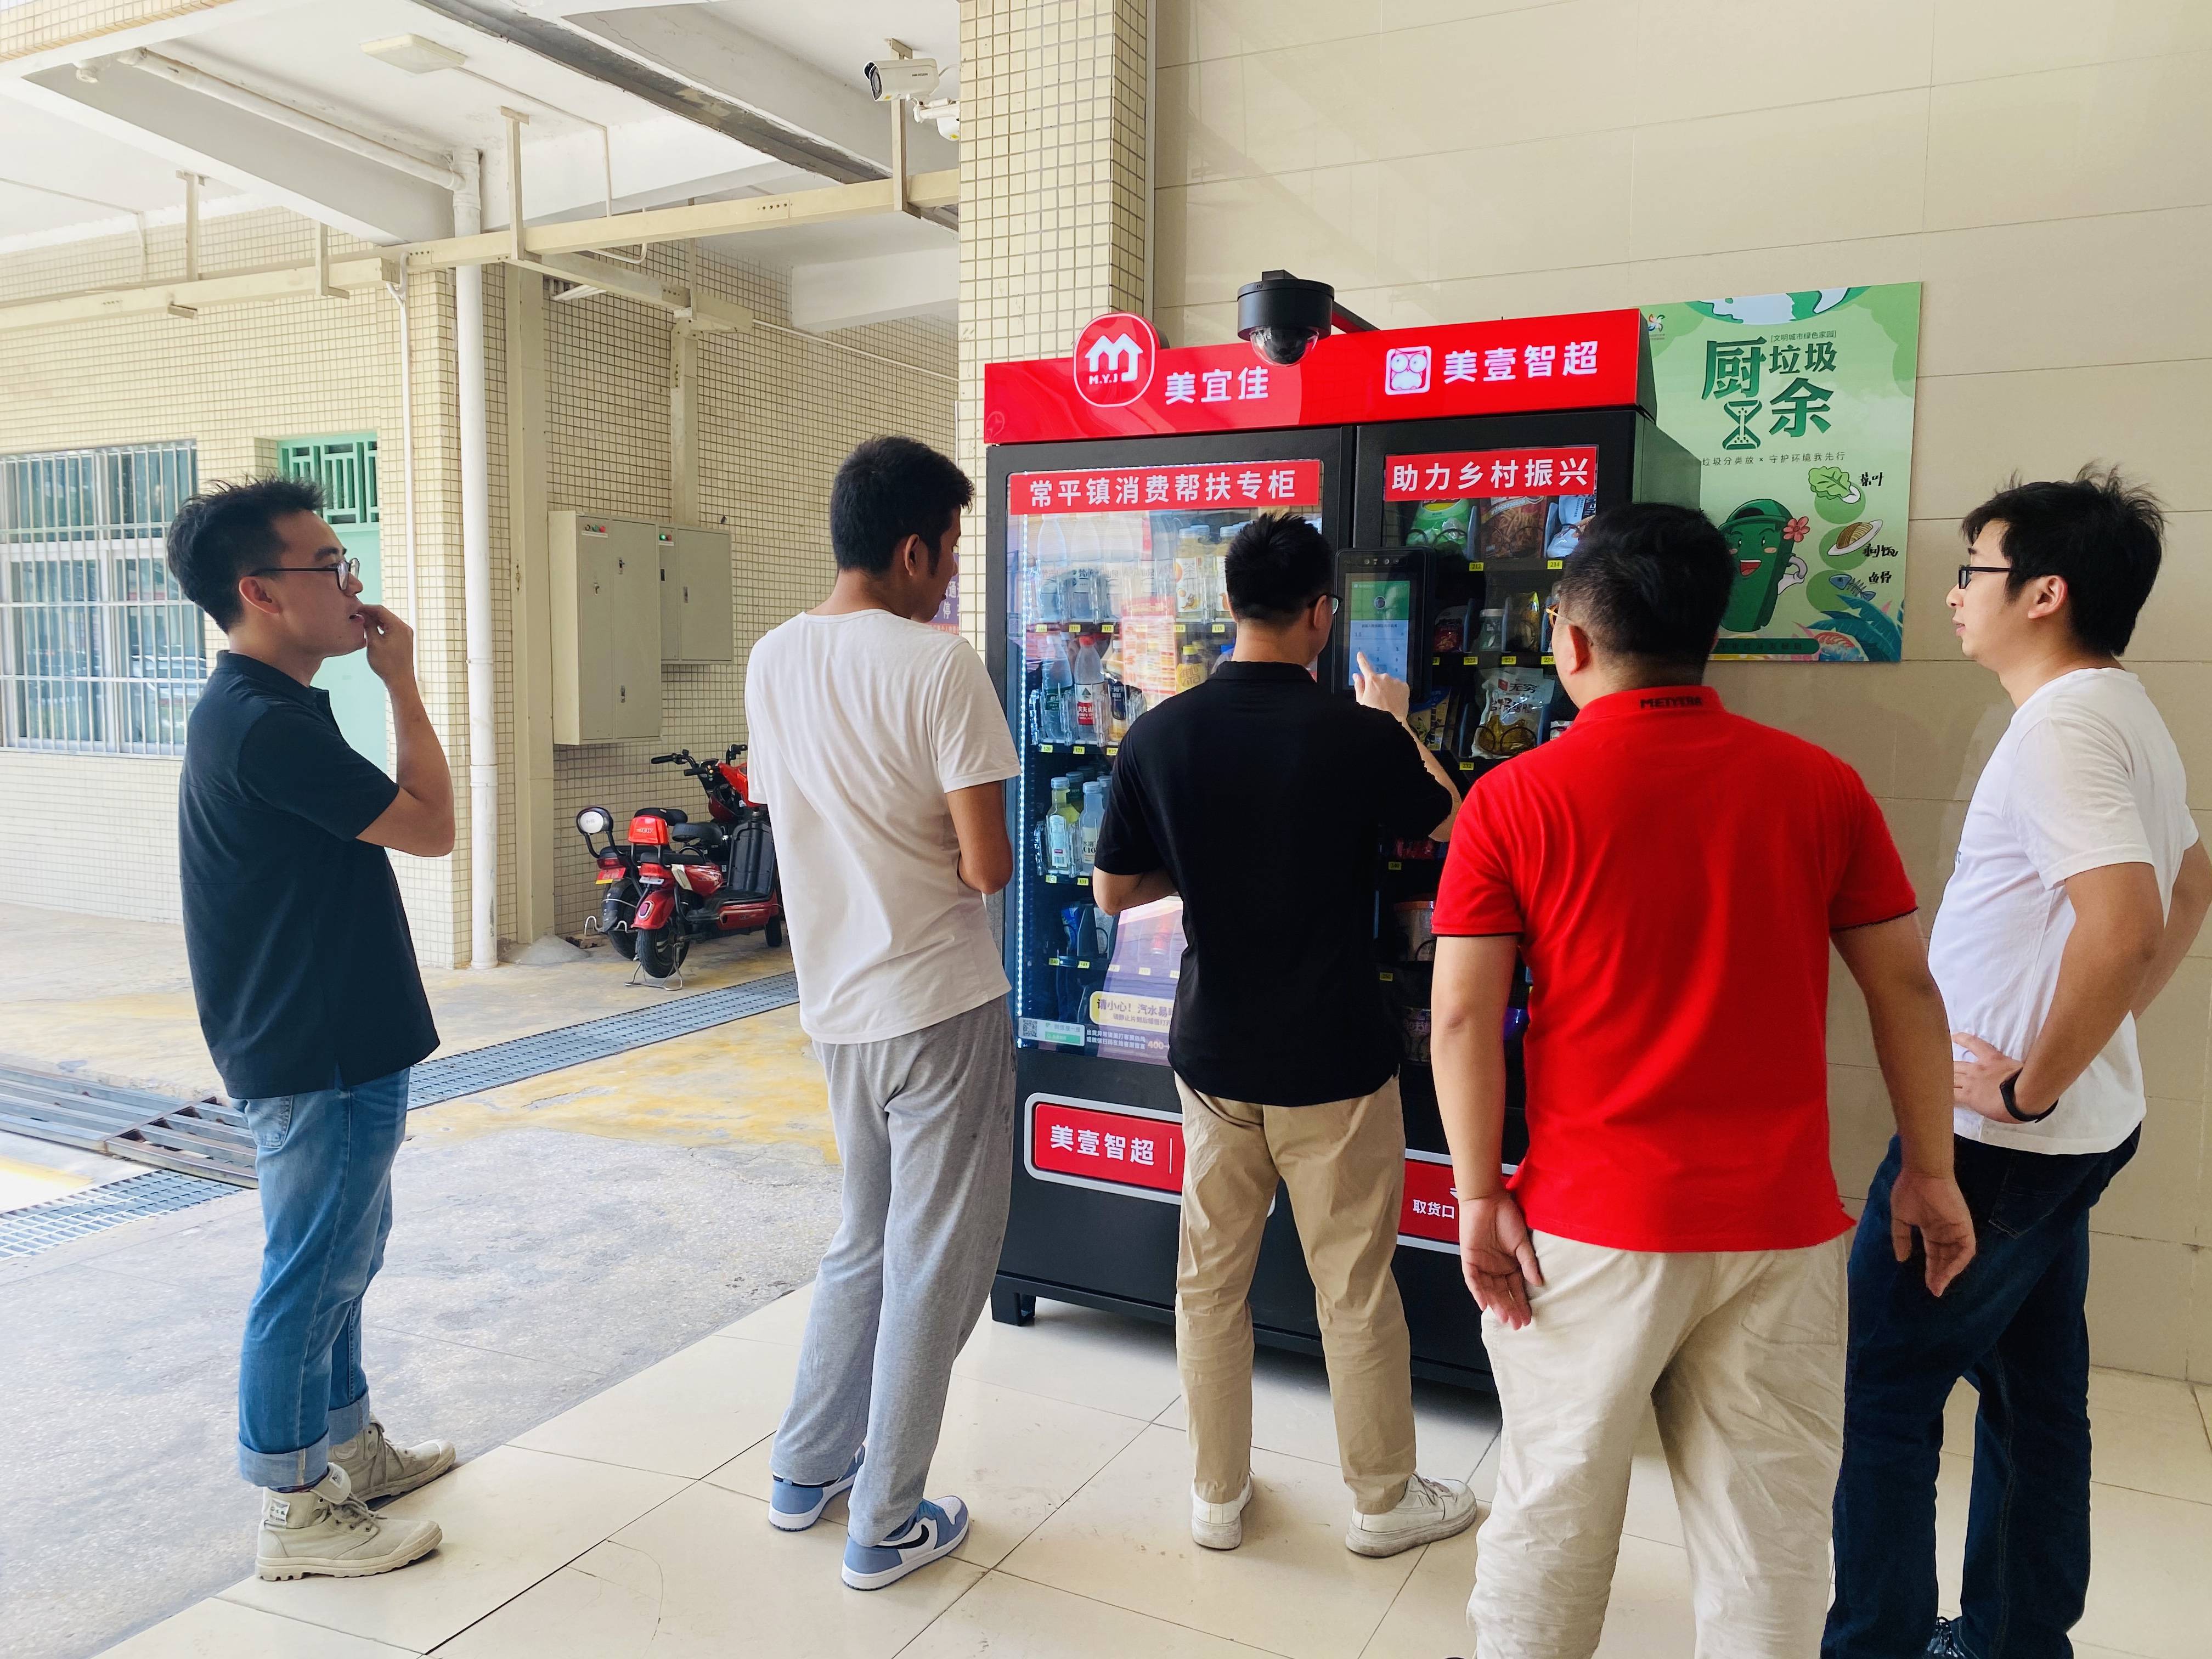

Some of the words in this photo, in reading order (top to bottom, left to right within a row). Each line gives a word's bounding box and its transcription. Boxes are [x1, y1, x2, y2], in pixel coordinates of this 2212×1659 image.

[1443, 341, 1598, 385] 美壹智超
[1701, 336, 1767, 400] 厨
[1769, 341, 1837, 374] 垃圾
[1165, 366, 1269, 405] 美宜佳
[1769, 377, 1834, 438] 余
[1030, 469, 1296, 507] 常平镇消费帮扶专柜
[1391, 457, 1589, 493] 助力乡村振兴
[1148, 1040, 1169, 1050] 400-
[1049, 1124, 1155, 1166] 美壹智超
[1413, 1199, 1455, 1220] 取货口
